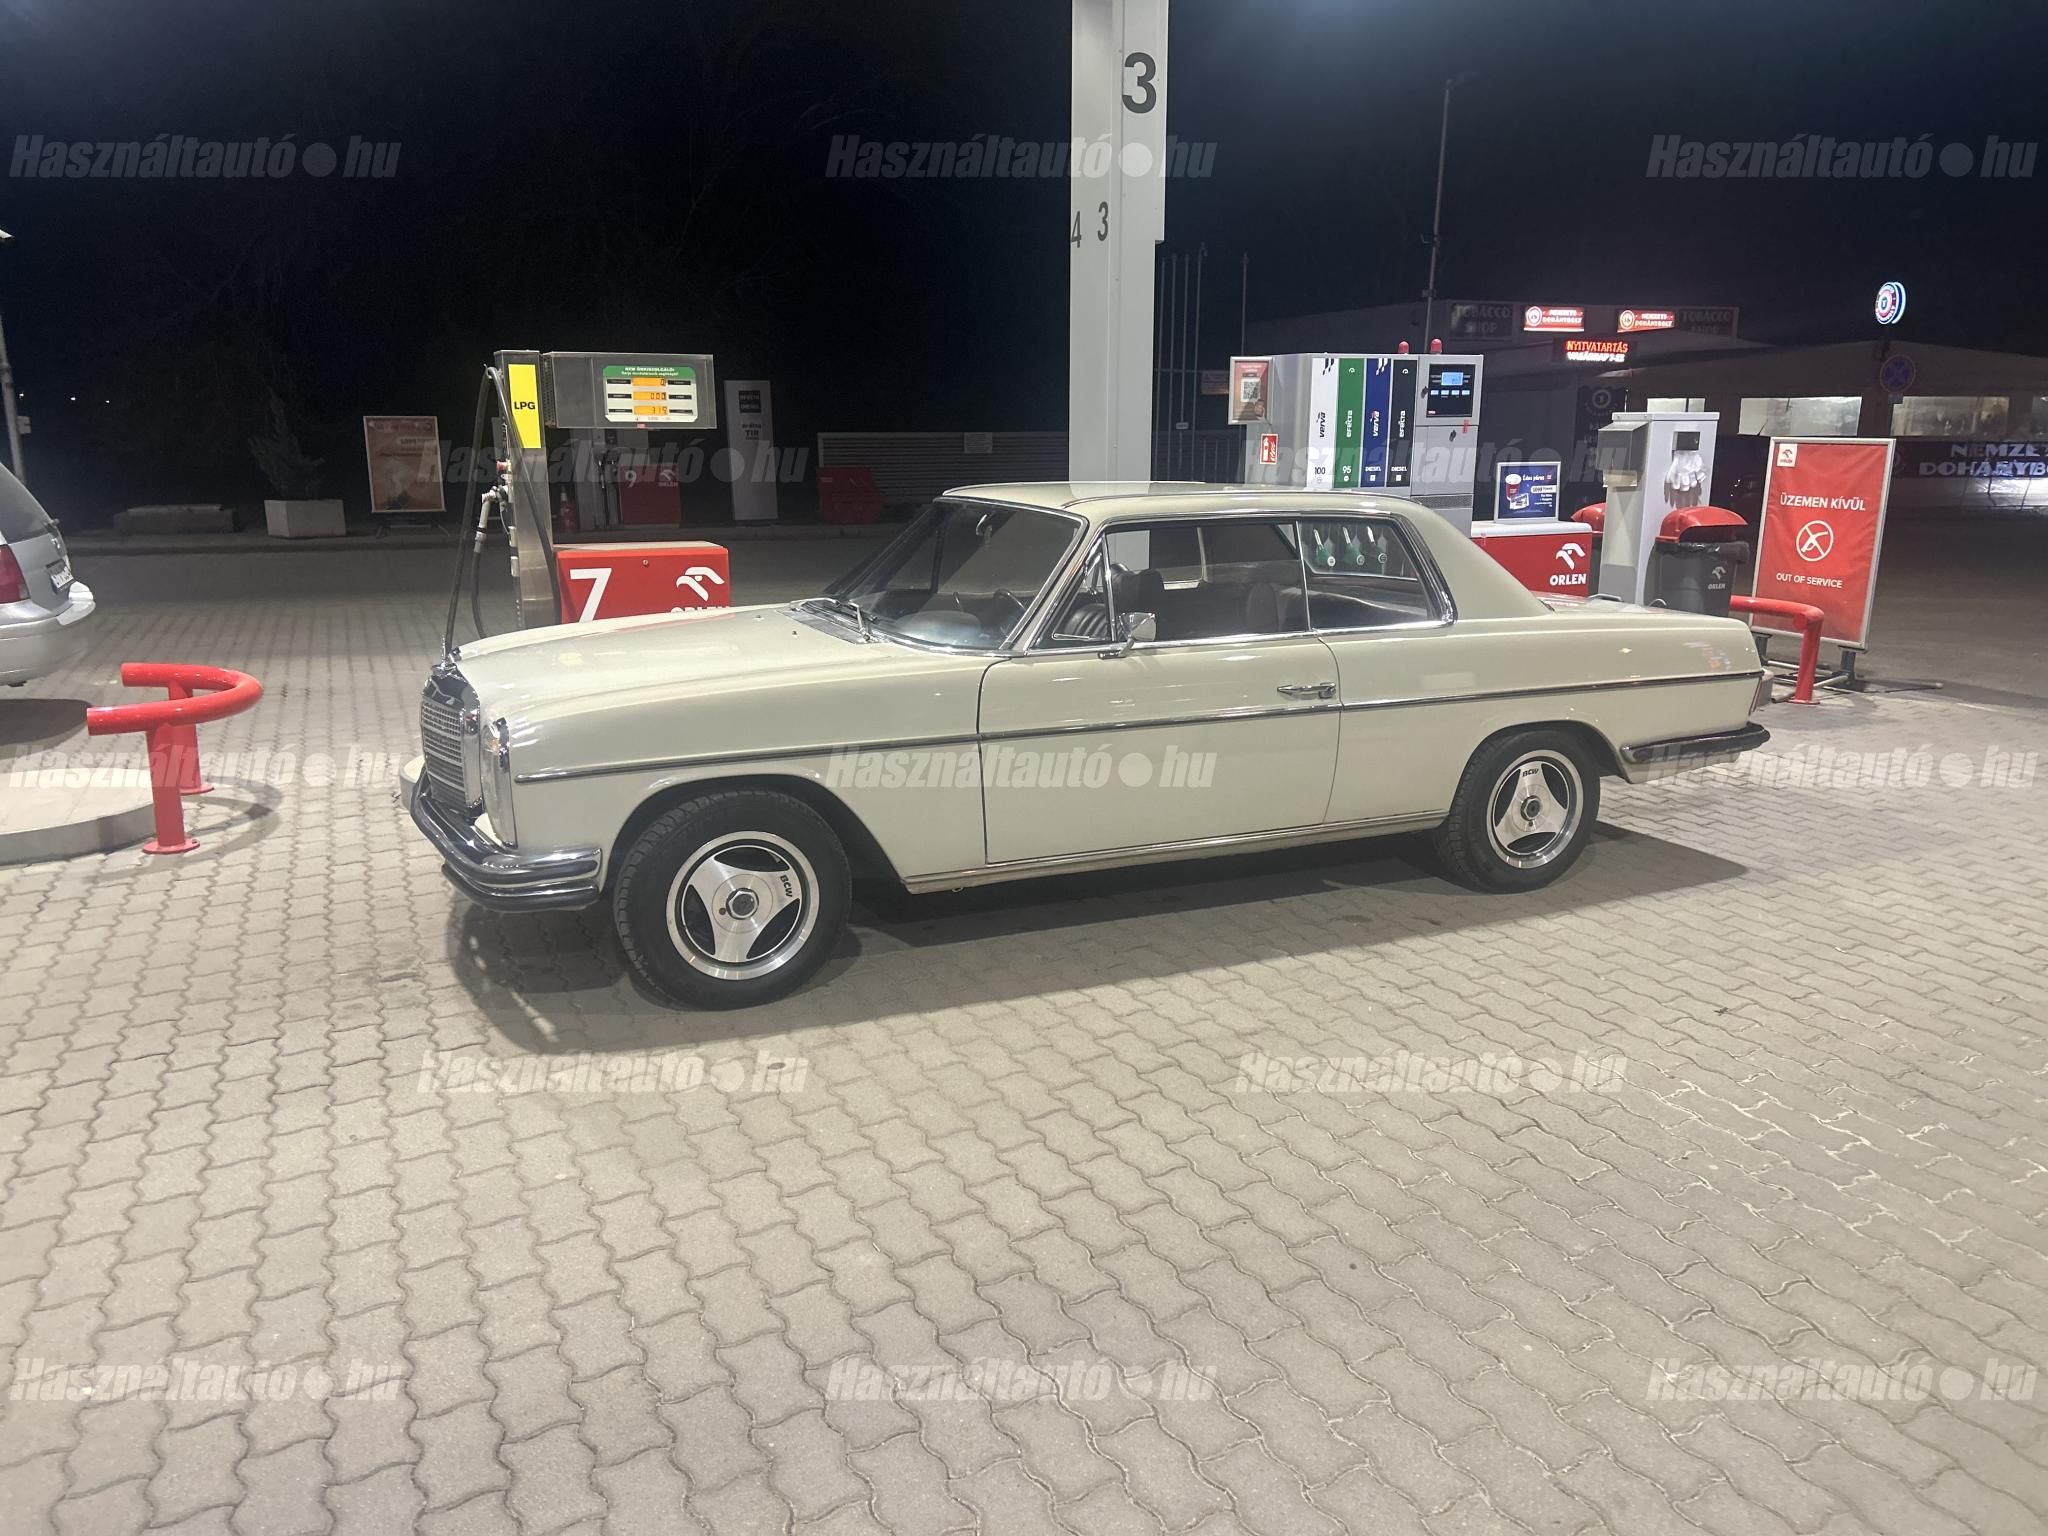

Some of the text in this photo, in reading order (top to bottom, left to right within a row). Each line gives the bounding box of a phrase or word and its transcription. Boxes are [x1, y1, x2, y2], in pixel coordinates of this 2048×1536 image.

[1122, 52, 1156, 114] 3
[1070, 201, 1109, 248] 4 3
[514, 401, 536, 410] LPG
[1314, 467, 1326, 475] 100
[1342, 465, 1352, 473] 95
[1919, 457, 2048, 477] DOHÁNYB
[625, 470, 637, 489] 9
[1780, 492, 1828, 509] ÜZEMEN
[1549, 573, 1587, 586] ORLEN
[1776, 572, 1843, 589] OUT OF SERVICE
[569, 568, 612, 624] 7
